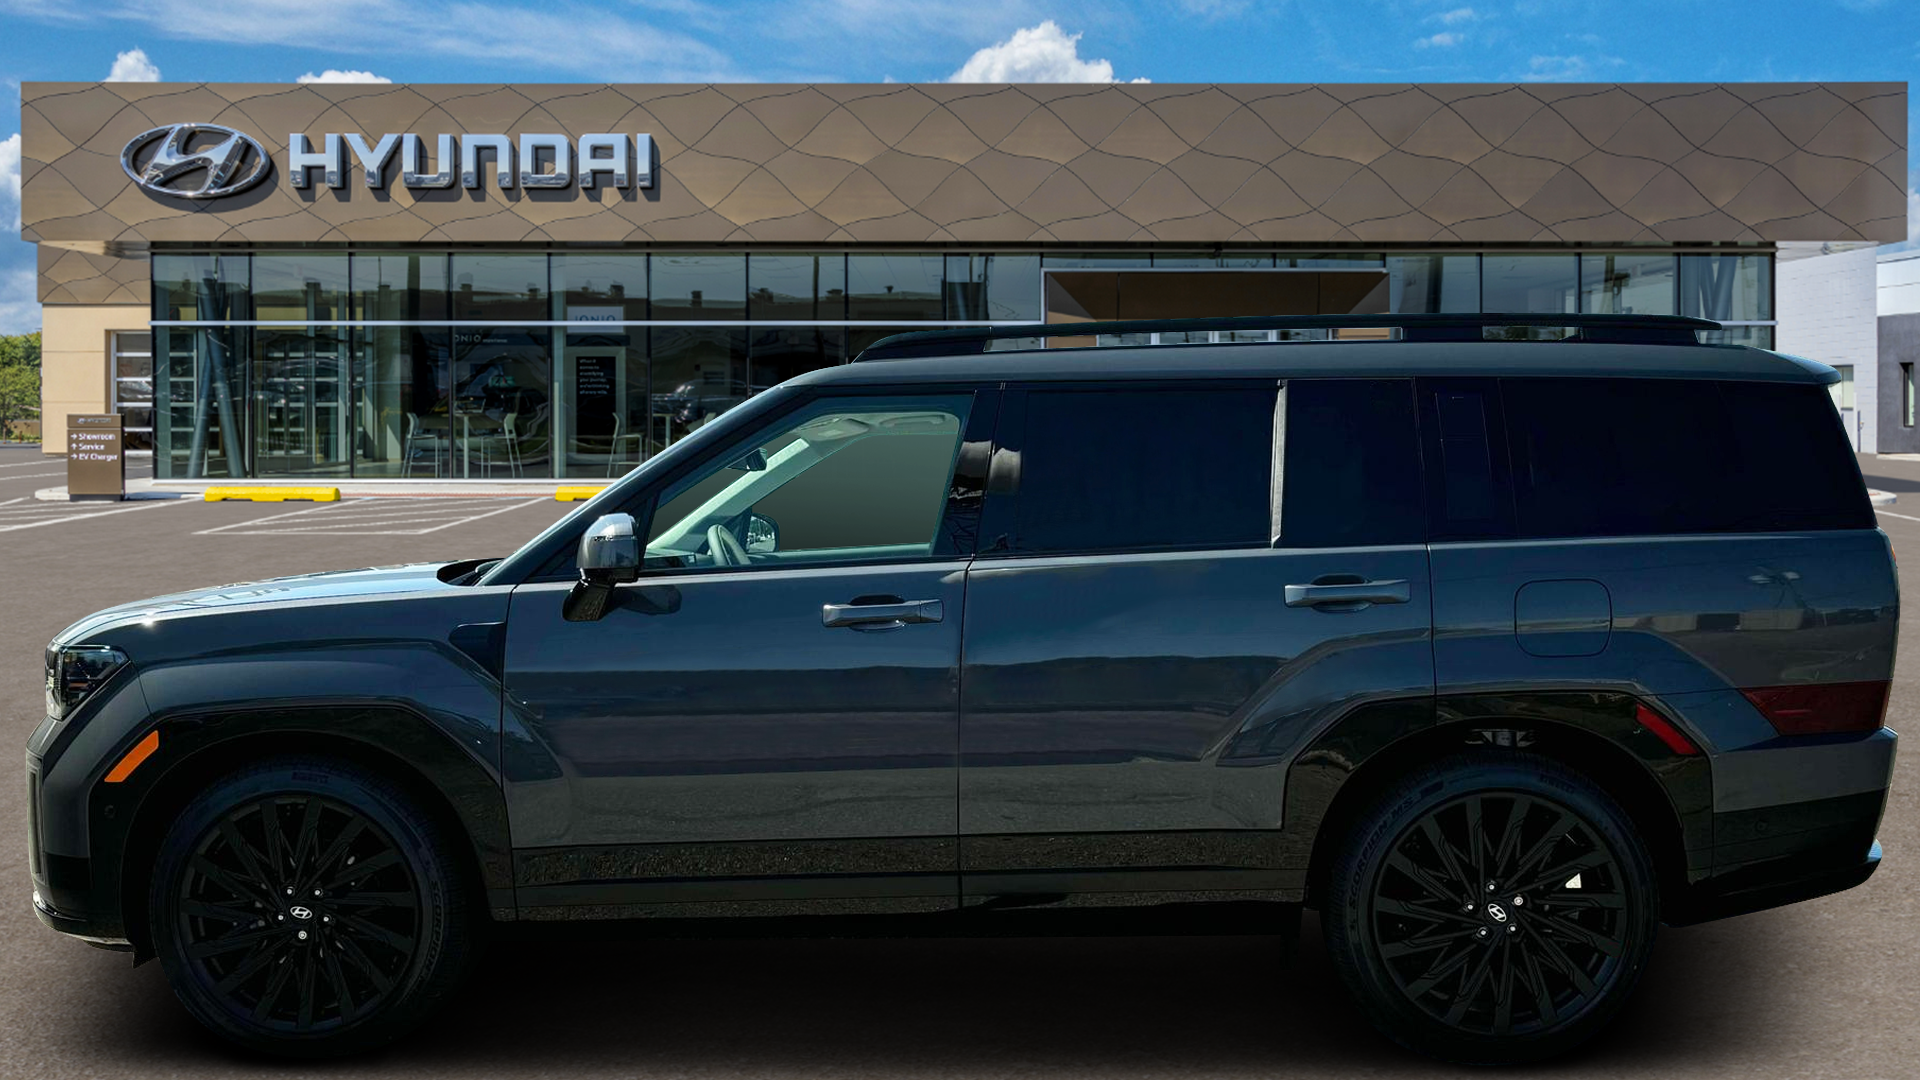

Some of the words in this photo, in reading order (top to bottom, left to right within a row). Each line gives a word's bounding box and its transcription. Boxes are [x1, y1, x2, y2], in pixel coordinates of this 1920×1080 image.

[289, 133, 653, 189] HYUNDAI
[78, 432, 116, 440] Showroom
[78, 442, 105, 450] Service
[90, 453, 118, 462] Charger
